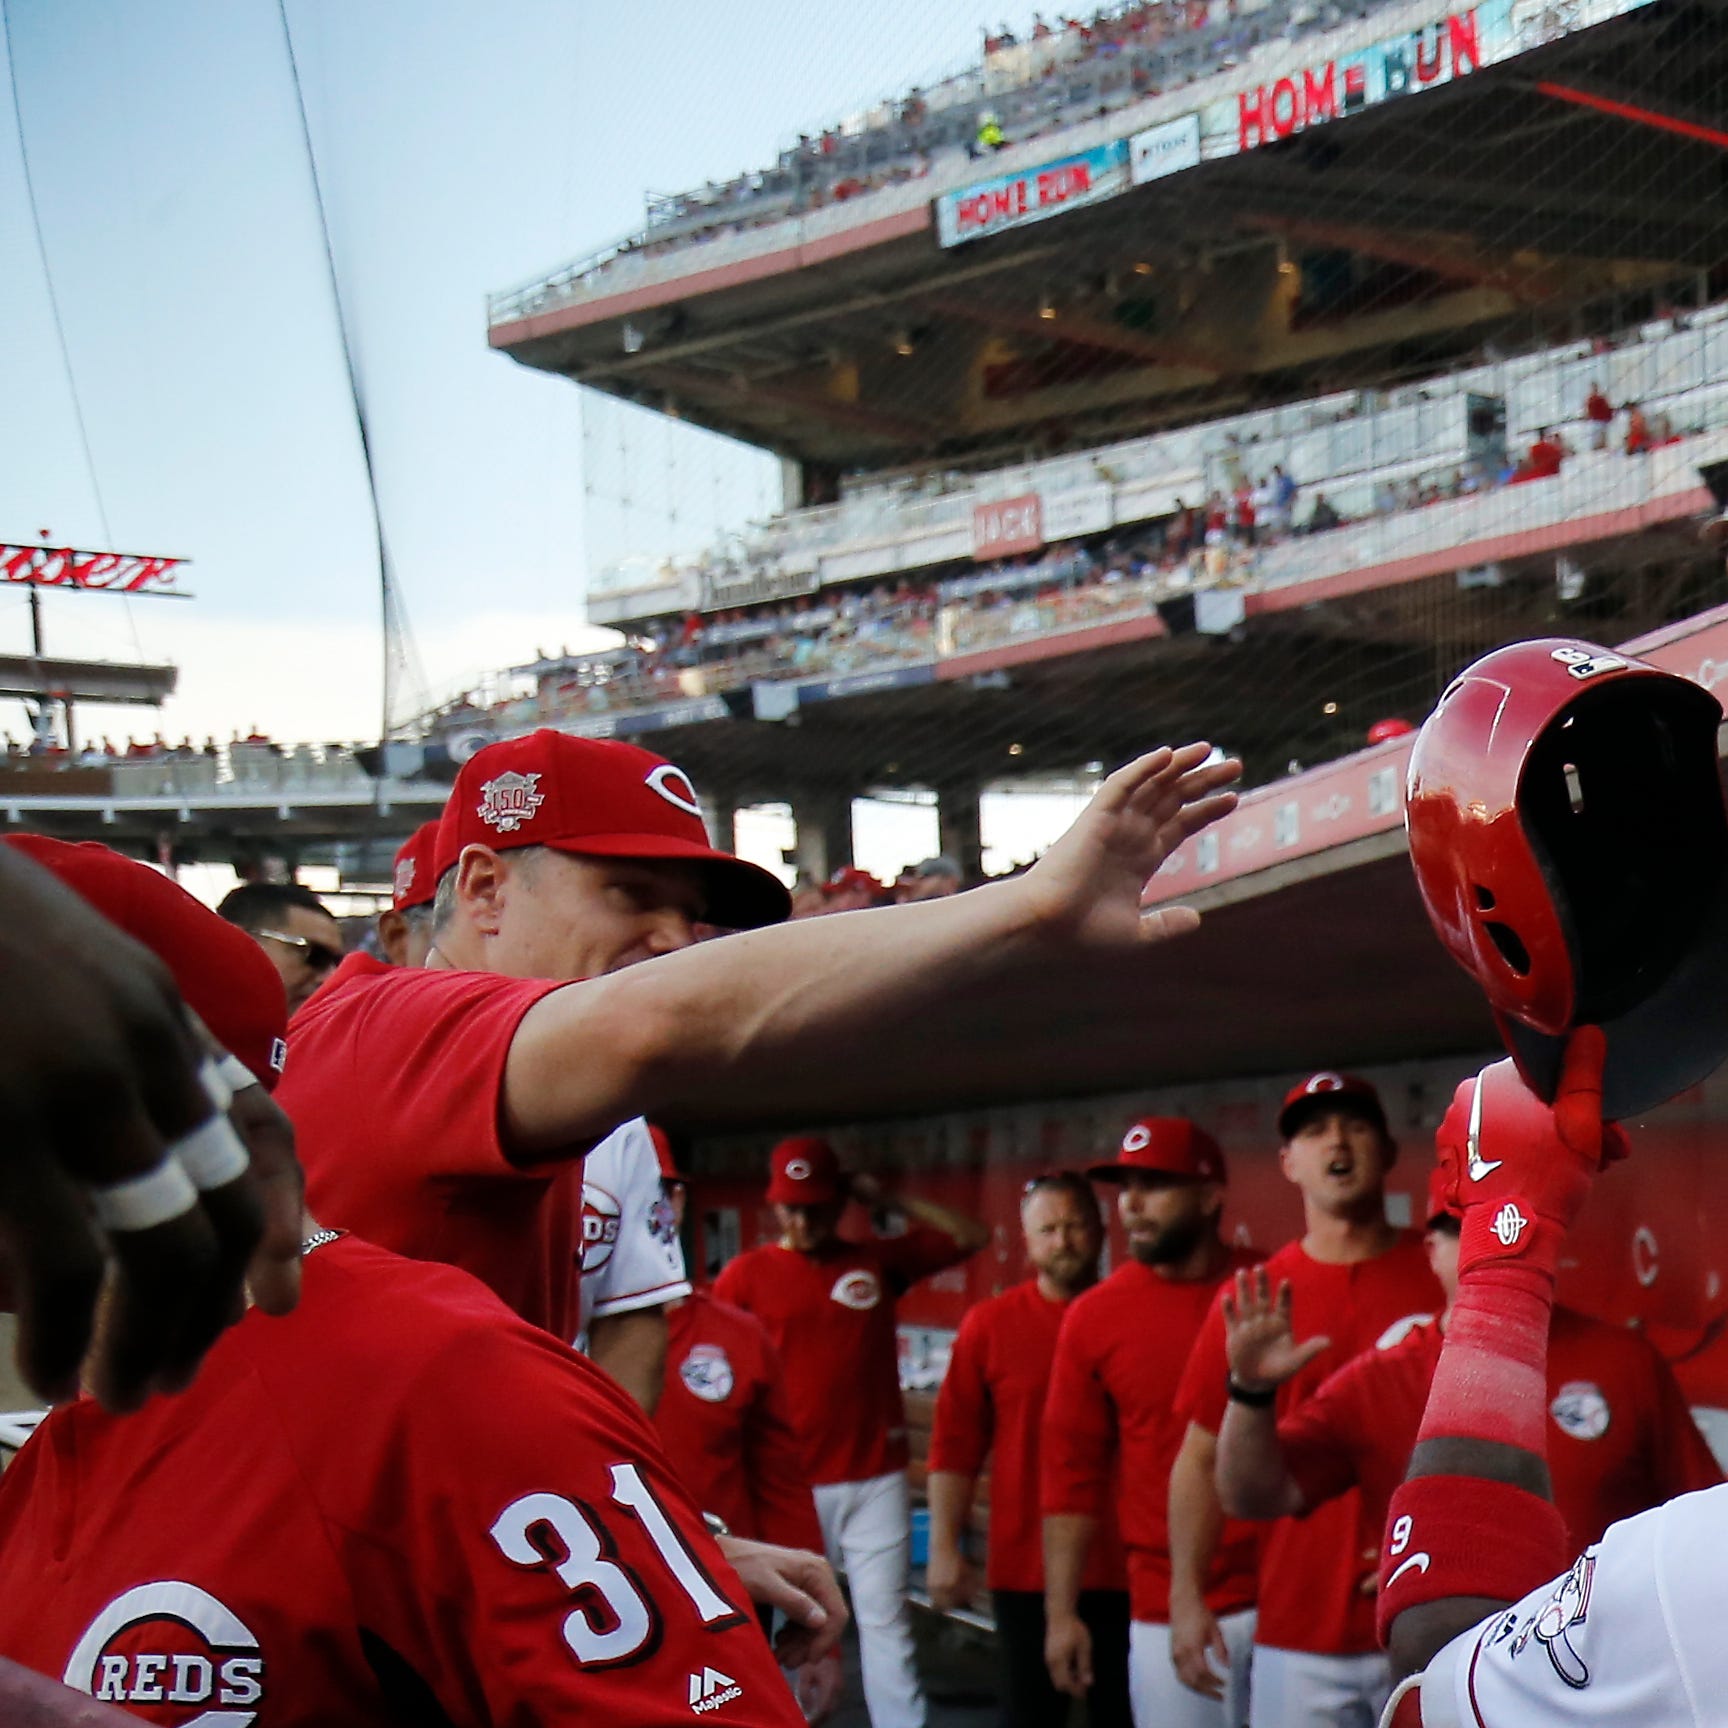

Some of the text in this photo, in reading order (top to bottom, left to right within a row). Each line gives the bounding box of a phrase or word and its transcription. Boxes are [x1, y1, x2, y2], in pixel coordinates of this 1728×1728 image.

[583, 1215, 619, 1243] DS
[489, 1462, 748, 1668] 31
[95, 1653, 265, 1706] REDS
[691, 1686, 743, 1716] Majestic
